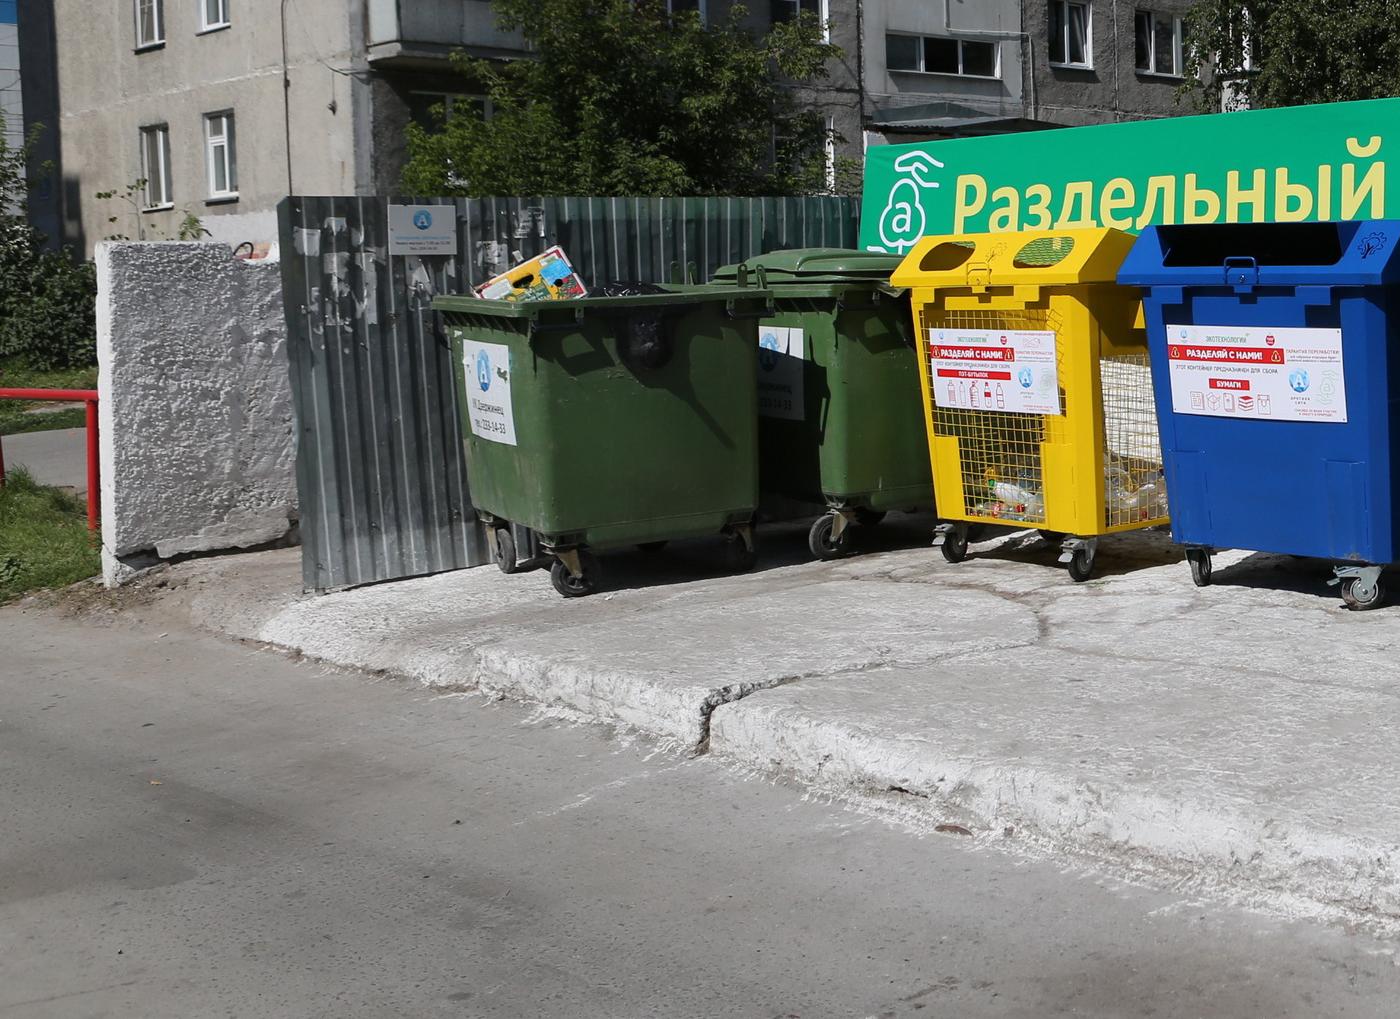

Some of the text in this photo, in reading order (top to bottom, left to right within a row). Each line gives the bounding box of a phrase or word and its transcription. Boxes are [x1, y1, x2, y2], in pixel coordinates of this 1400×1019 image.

[953, 136, 1385, 236] Раздельный
[940, 348, 974, 359] РАЗДЕЛЯЙ
[981, 351, 1003, 359] НАМИ!
[1186, 348, 1263, 360] РАЗДЕЛЯЙ С НАМИ!
[1216, 380, 1241, 389] БУМАГИ
